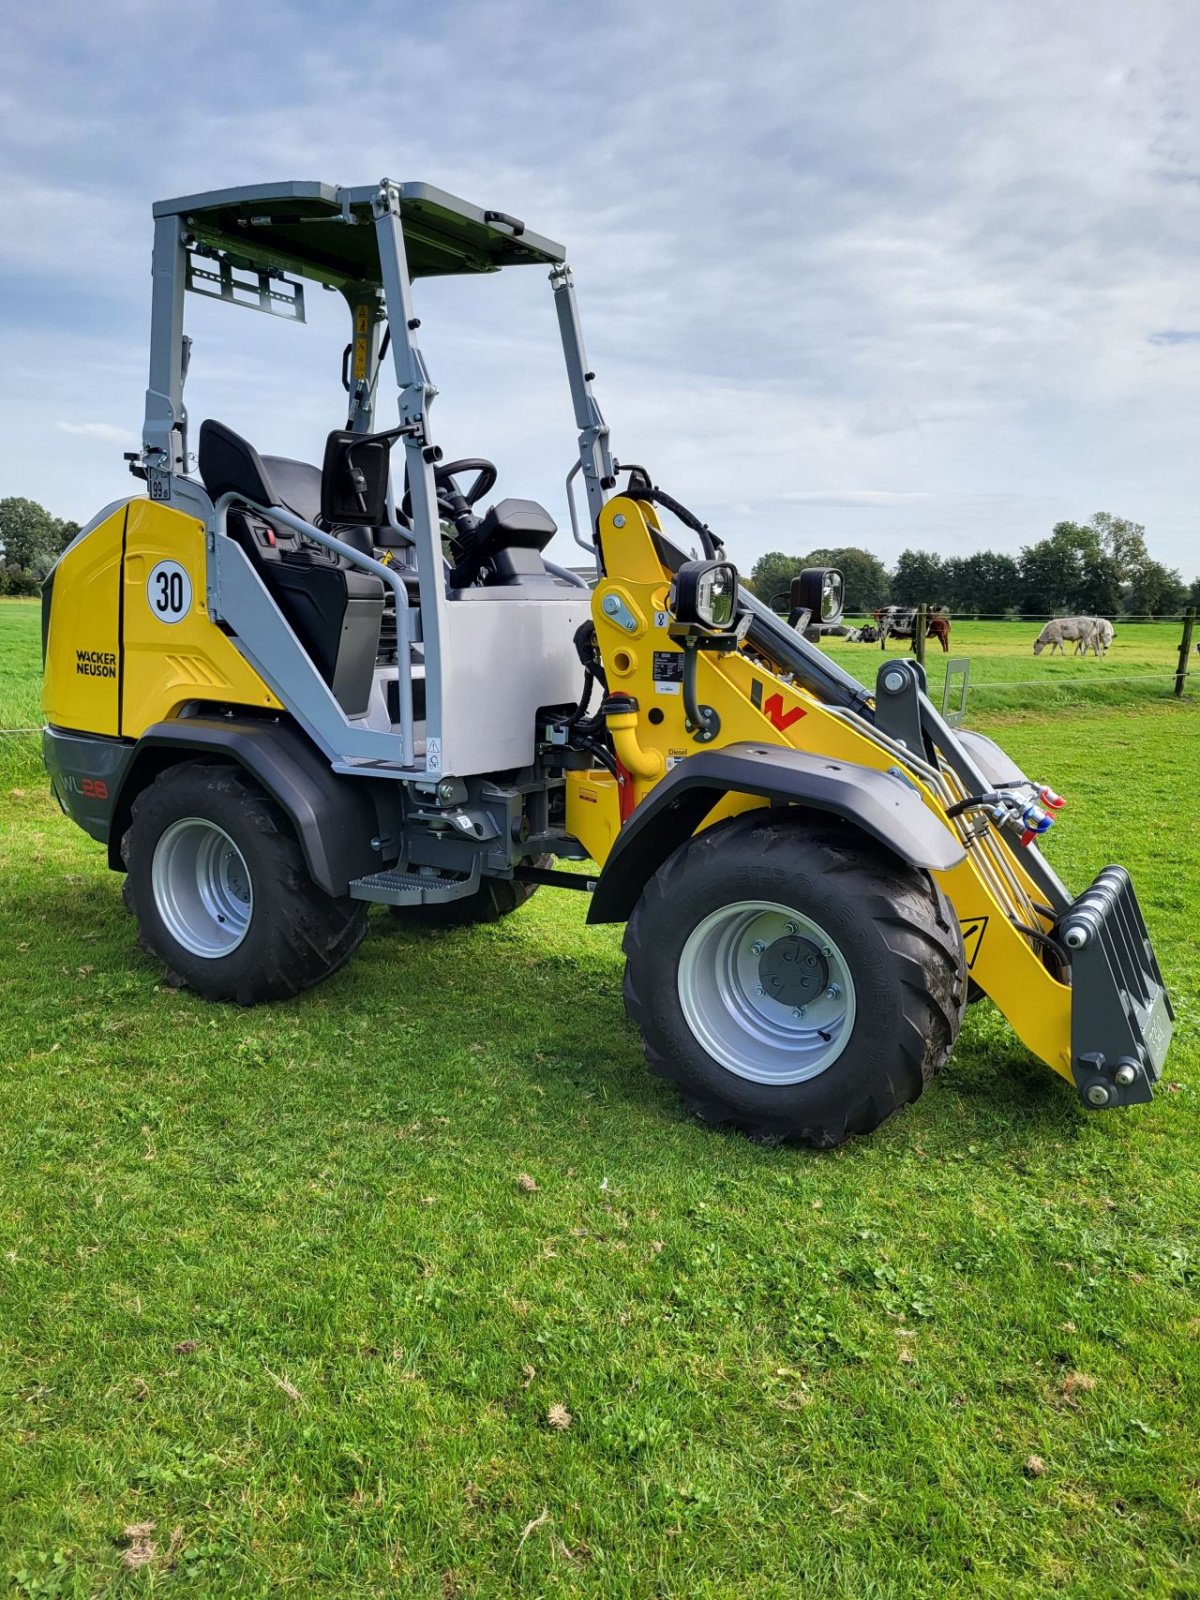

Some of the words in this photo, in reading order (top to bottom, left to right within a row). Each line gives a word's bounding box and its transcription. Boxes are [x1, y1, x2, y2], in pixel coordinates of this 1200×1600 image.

[153, 481, 162, 498] 99
[156, 571, 183, 613] 30
[76, 650, 116, 665] WACKER
[76, 662, 116, 679] NEUSON
[668, 748, 688, 756] Diesel
